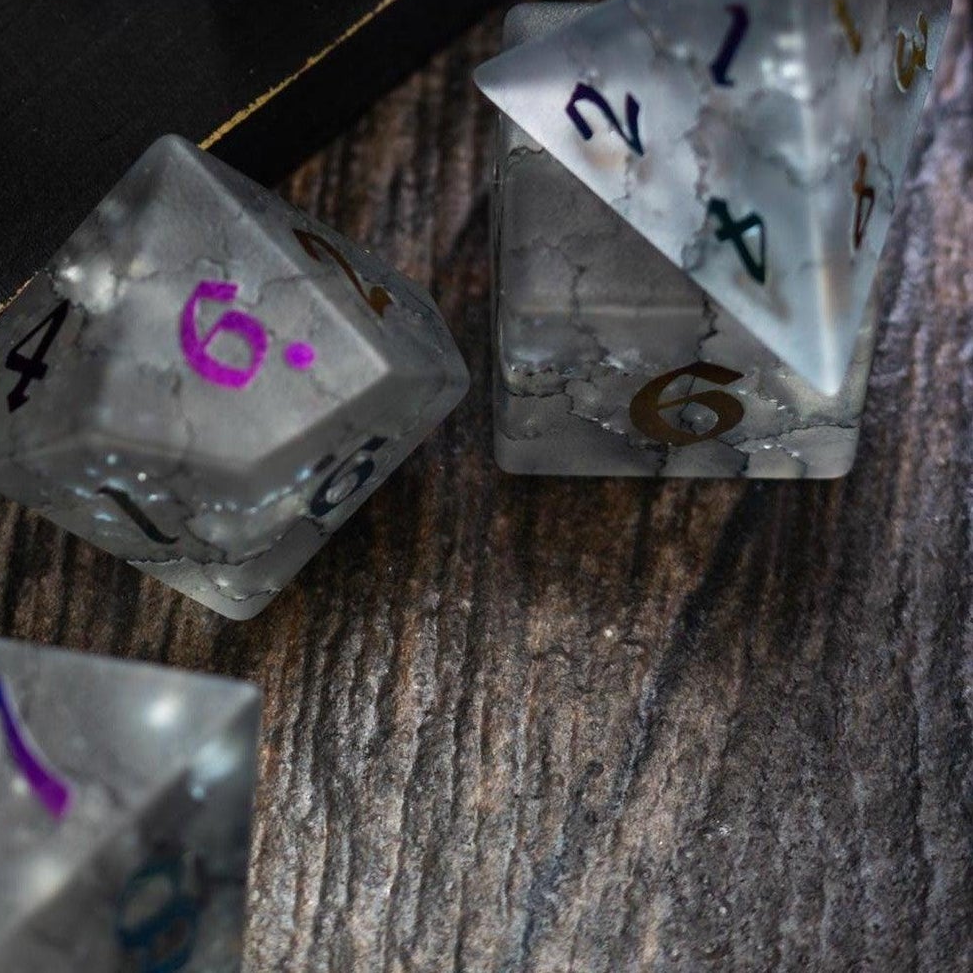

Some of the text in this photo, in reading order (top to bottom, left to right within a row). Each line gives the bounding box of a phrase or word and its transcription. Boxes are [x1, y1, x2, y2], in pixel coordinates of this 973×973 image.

[711, 3, 750, 89] 1
[564, 82, 644, 156] 2
[707, 196, 767, 286] 4
[6, 299, 70, 413] 4
[630, 361, 745, 447] 6
